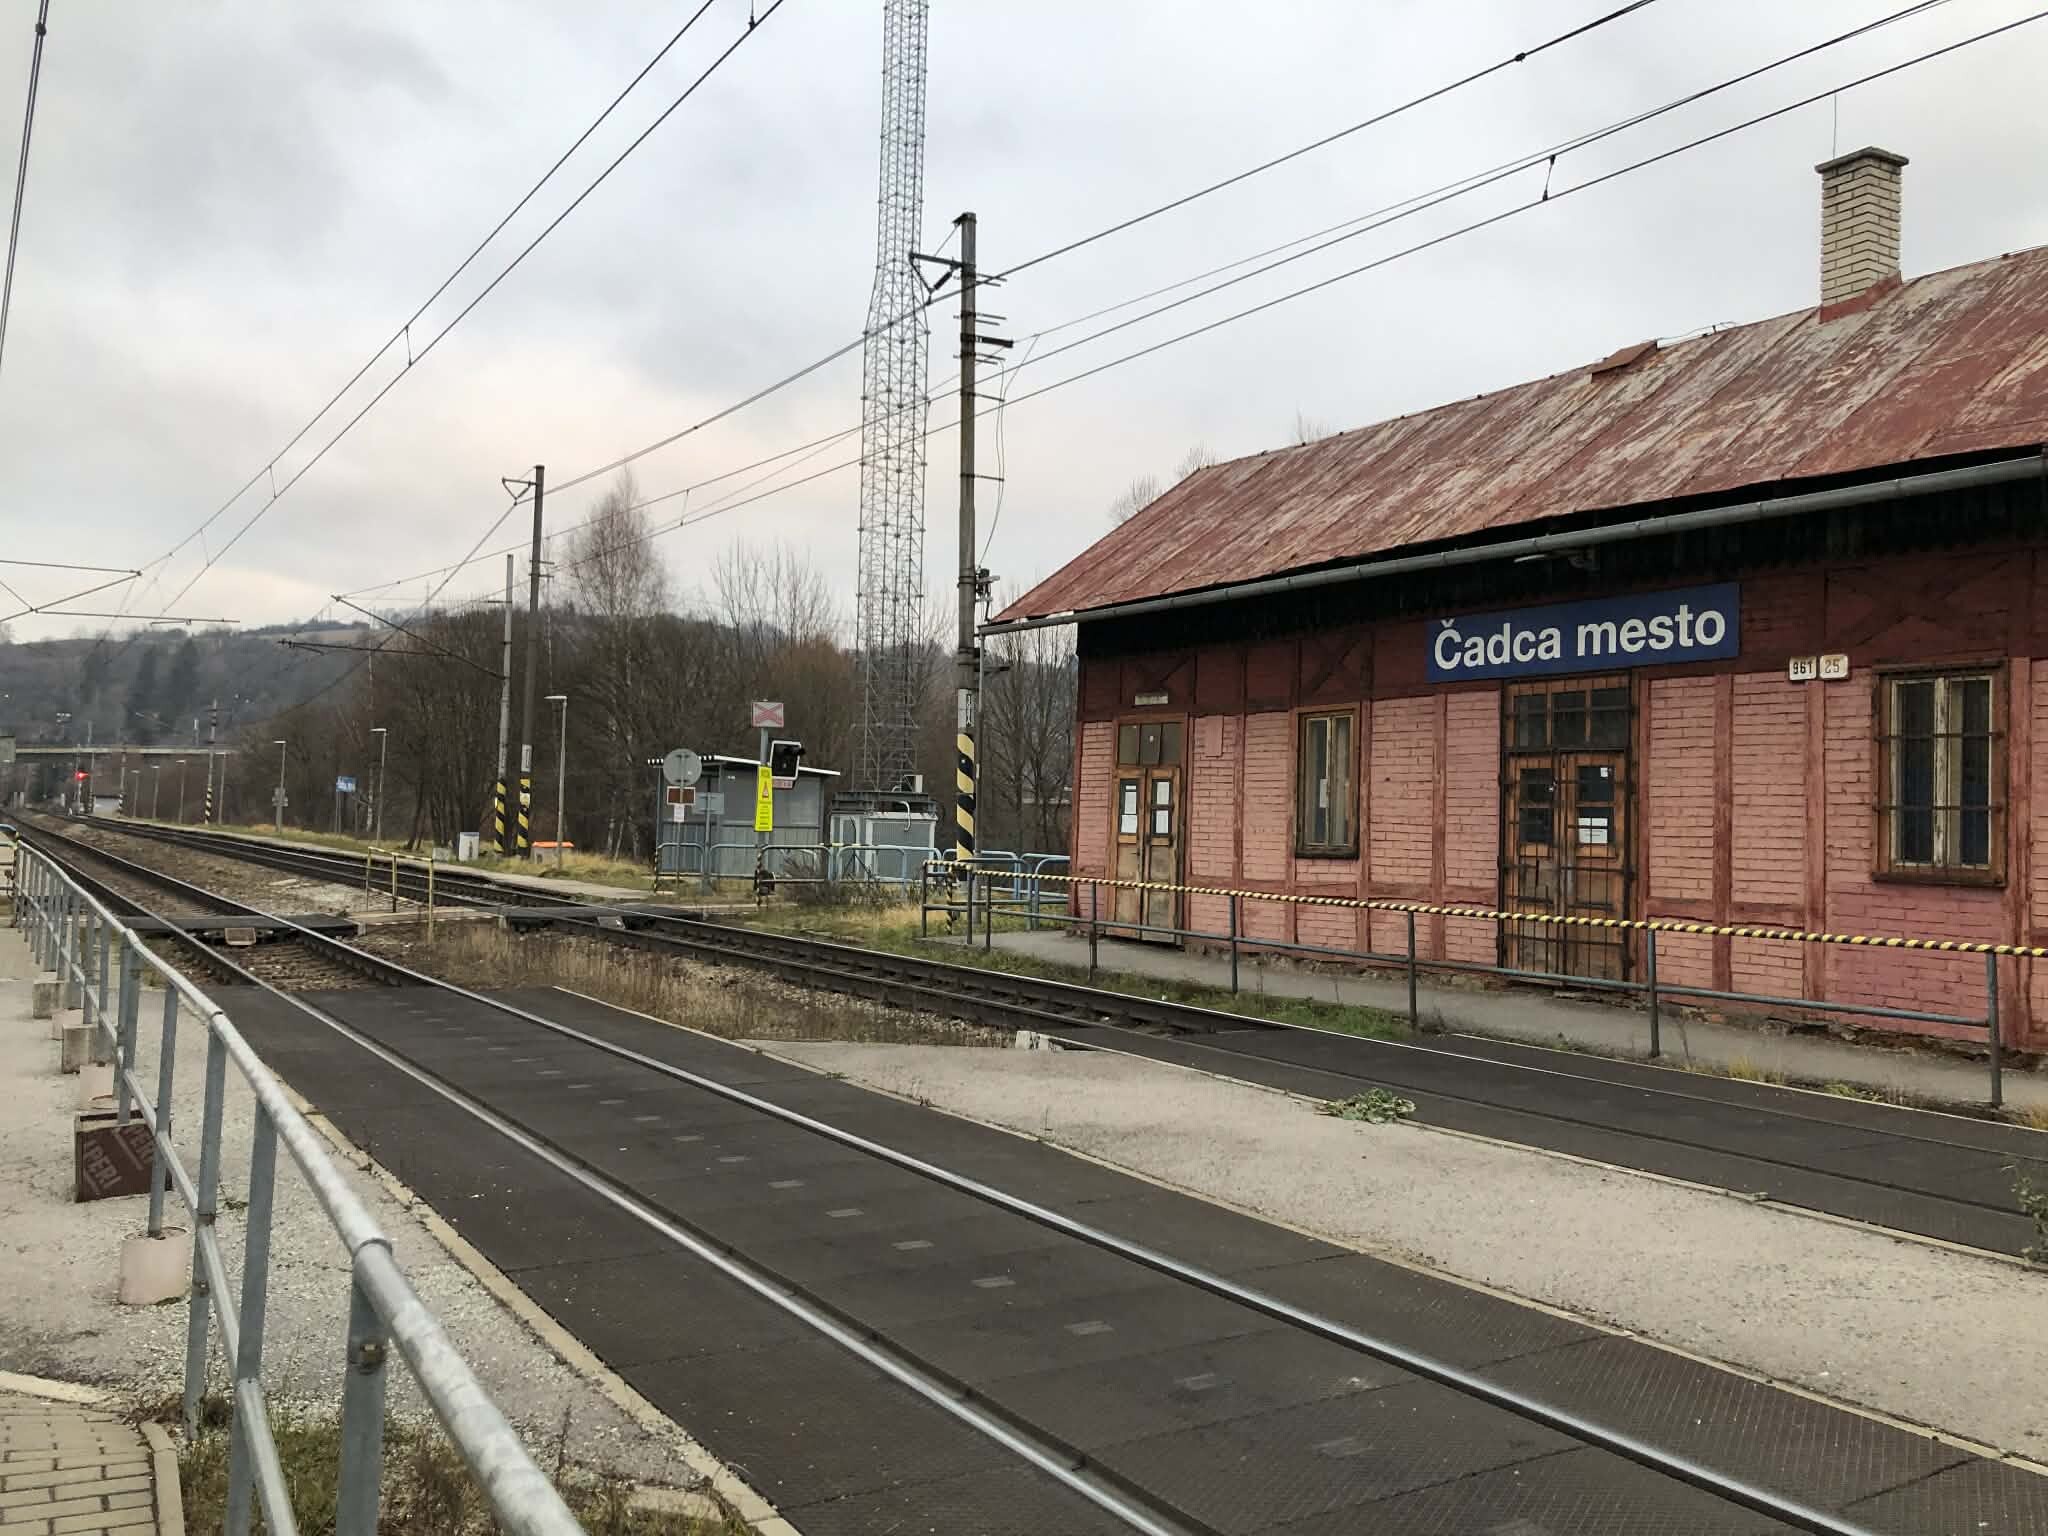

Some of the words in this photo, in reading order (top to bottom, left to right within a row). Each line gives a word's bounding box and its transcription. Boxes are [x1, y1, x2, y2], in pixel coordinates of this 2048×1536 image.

[1434, 619, 1562, 670] Čadca
[1577, 604, 1726, 656] mesto
[1824, 658, 1841, 674] 25
